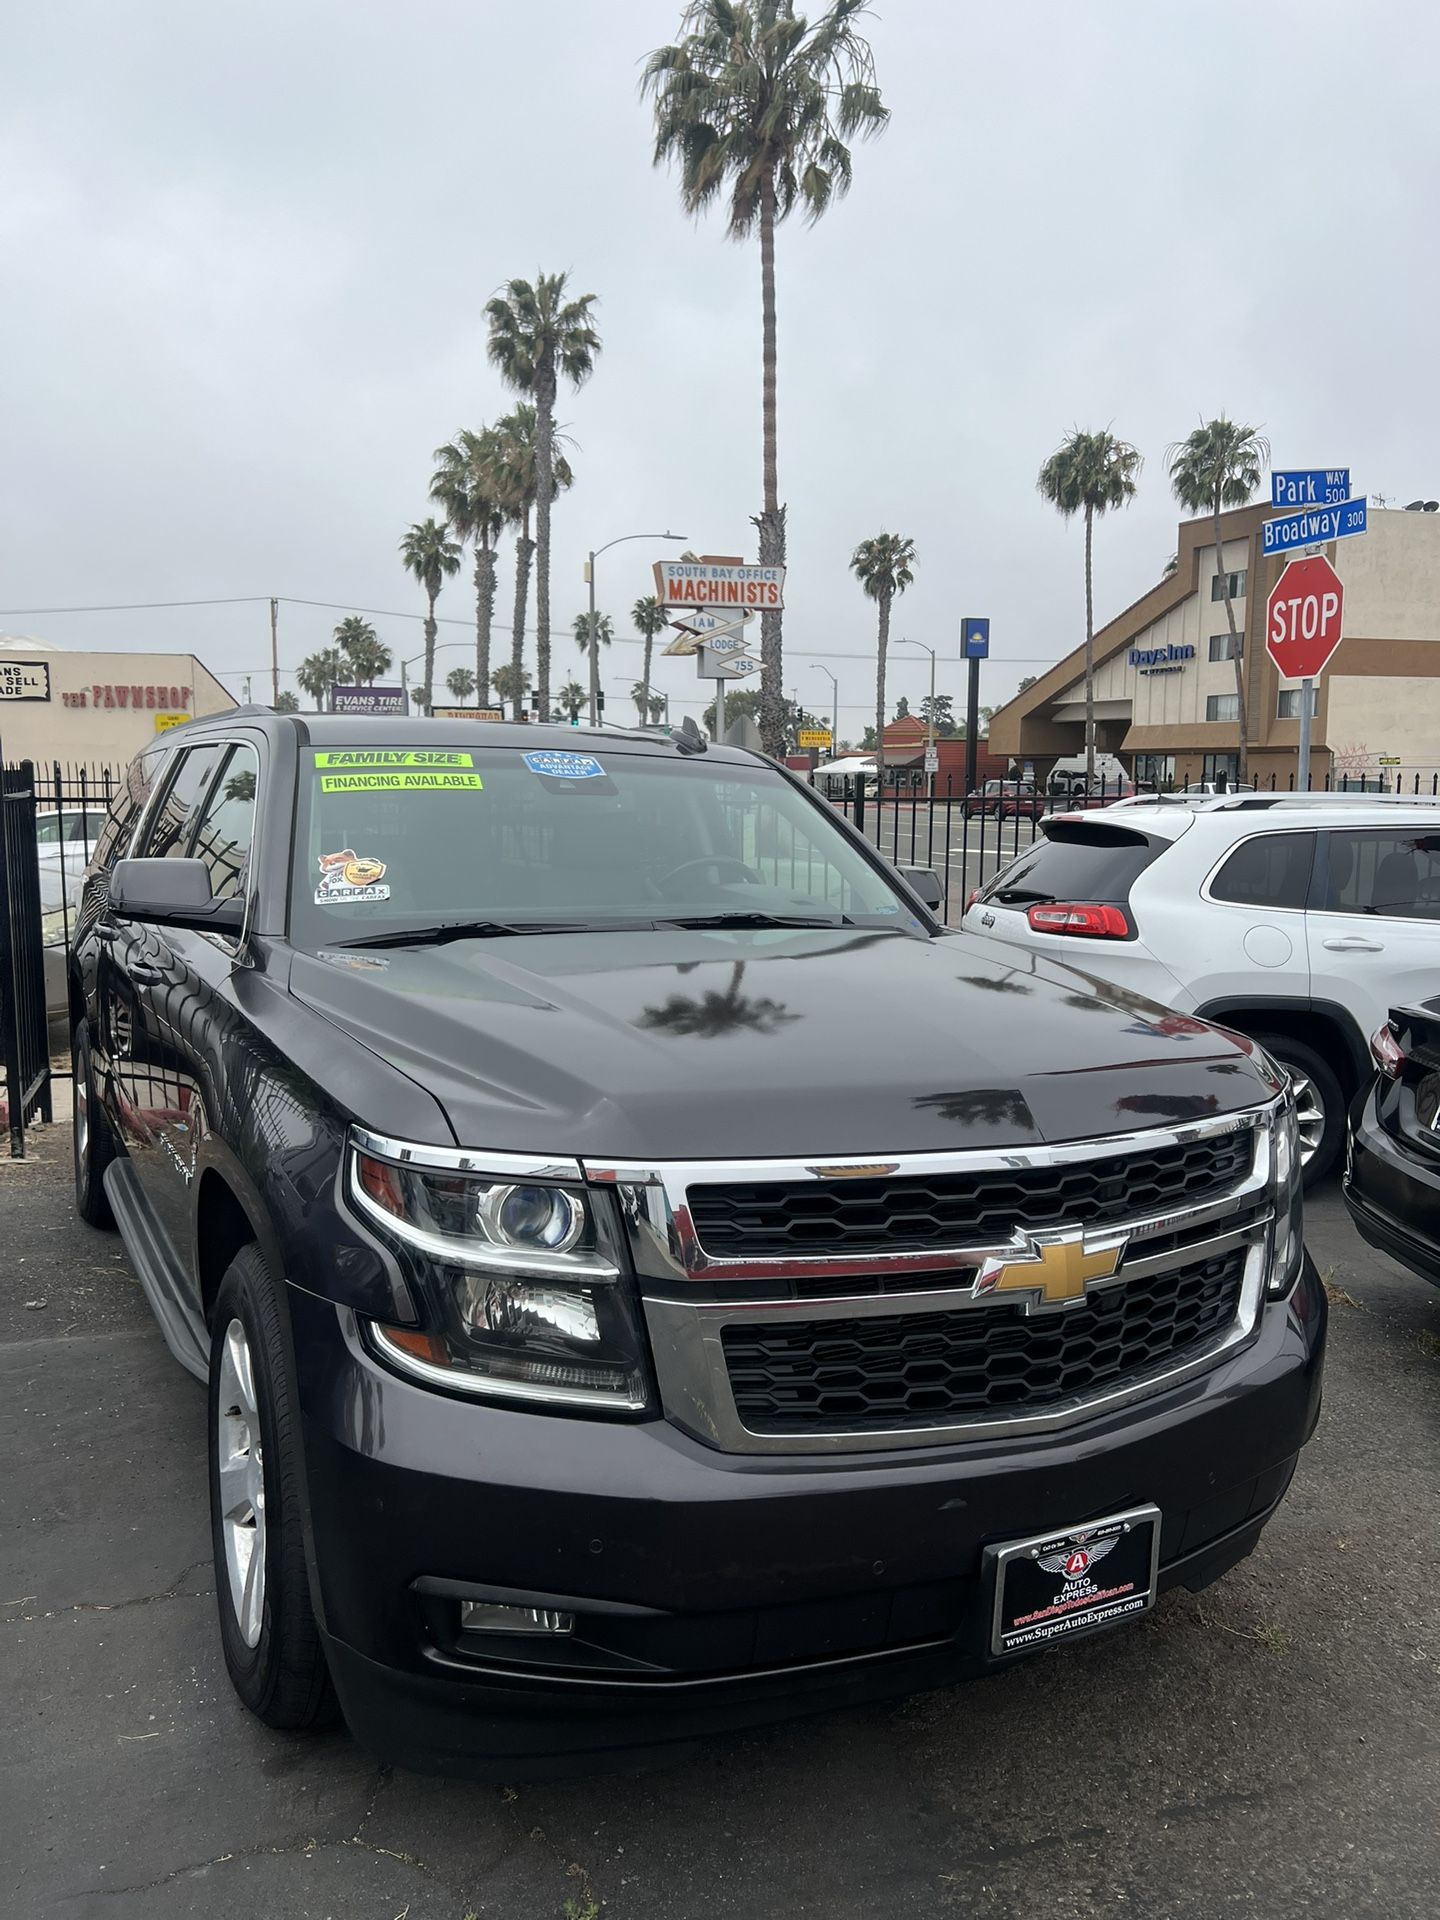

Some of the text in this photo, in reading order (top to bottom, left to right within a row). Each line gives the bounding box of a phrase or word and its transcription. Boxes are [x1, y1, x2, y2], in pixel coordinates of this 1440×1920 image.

[1275, 472, 1346, 503] Park WAY
[1325, 488, 1346, 503] 500
[1264, 510, 1364, 547] Broadway 300
[668, 566, 777, 580] SOUTH BAY OFFICE
[668, 579, 778, 604] MACHINISTS
[1271, 592, 1339, 643] STOP
[710, 639, 739, 649] LODGE
[1128, 643, 1195, 666] Days Inn
[734, 661, 754, 671] 755
[6, 677, 39, 686] SELL
[92, 685, 190, 709] PAWNSHOP
[335, 695, 376, 705] EVANS
[327, 752, 463, 765] FAMILY SIZE
[540, 763, 594, 771] ADVANTAGE
[325, 775, 478, 789] FINANCING AVAILABLE
[318, 887, 386, 898] CARFAX
[1070, 1554, 1087, 1572] A
[1062, 1577, 1091, 1593] AUTO
[1053, 1584, 1098, 1605] EXPRESS
[1006, 1599, 1143, 1648] www.SuperAutoExpress.com
